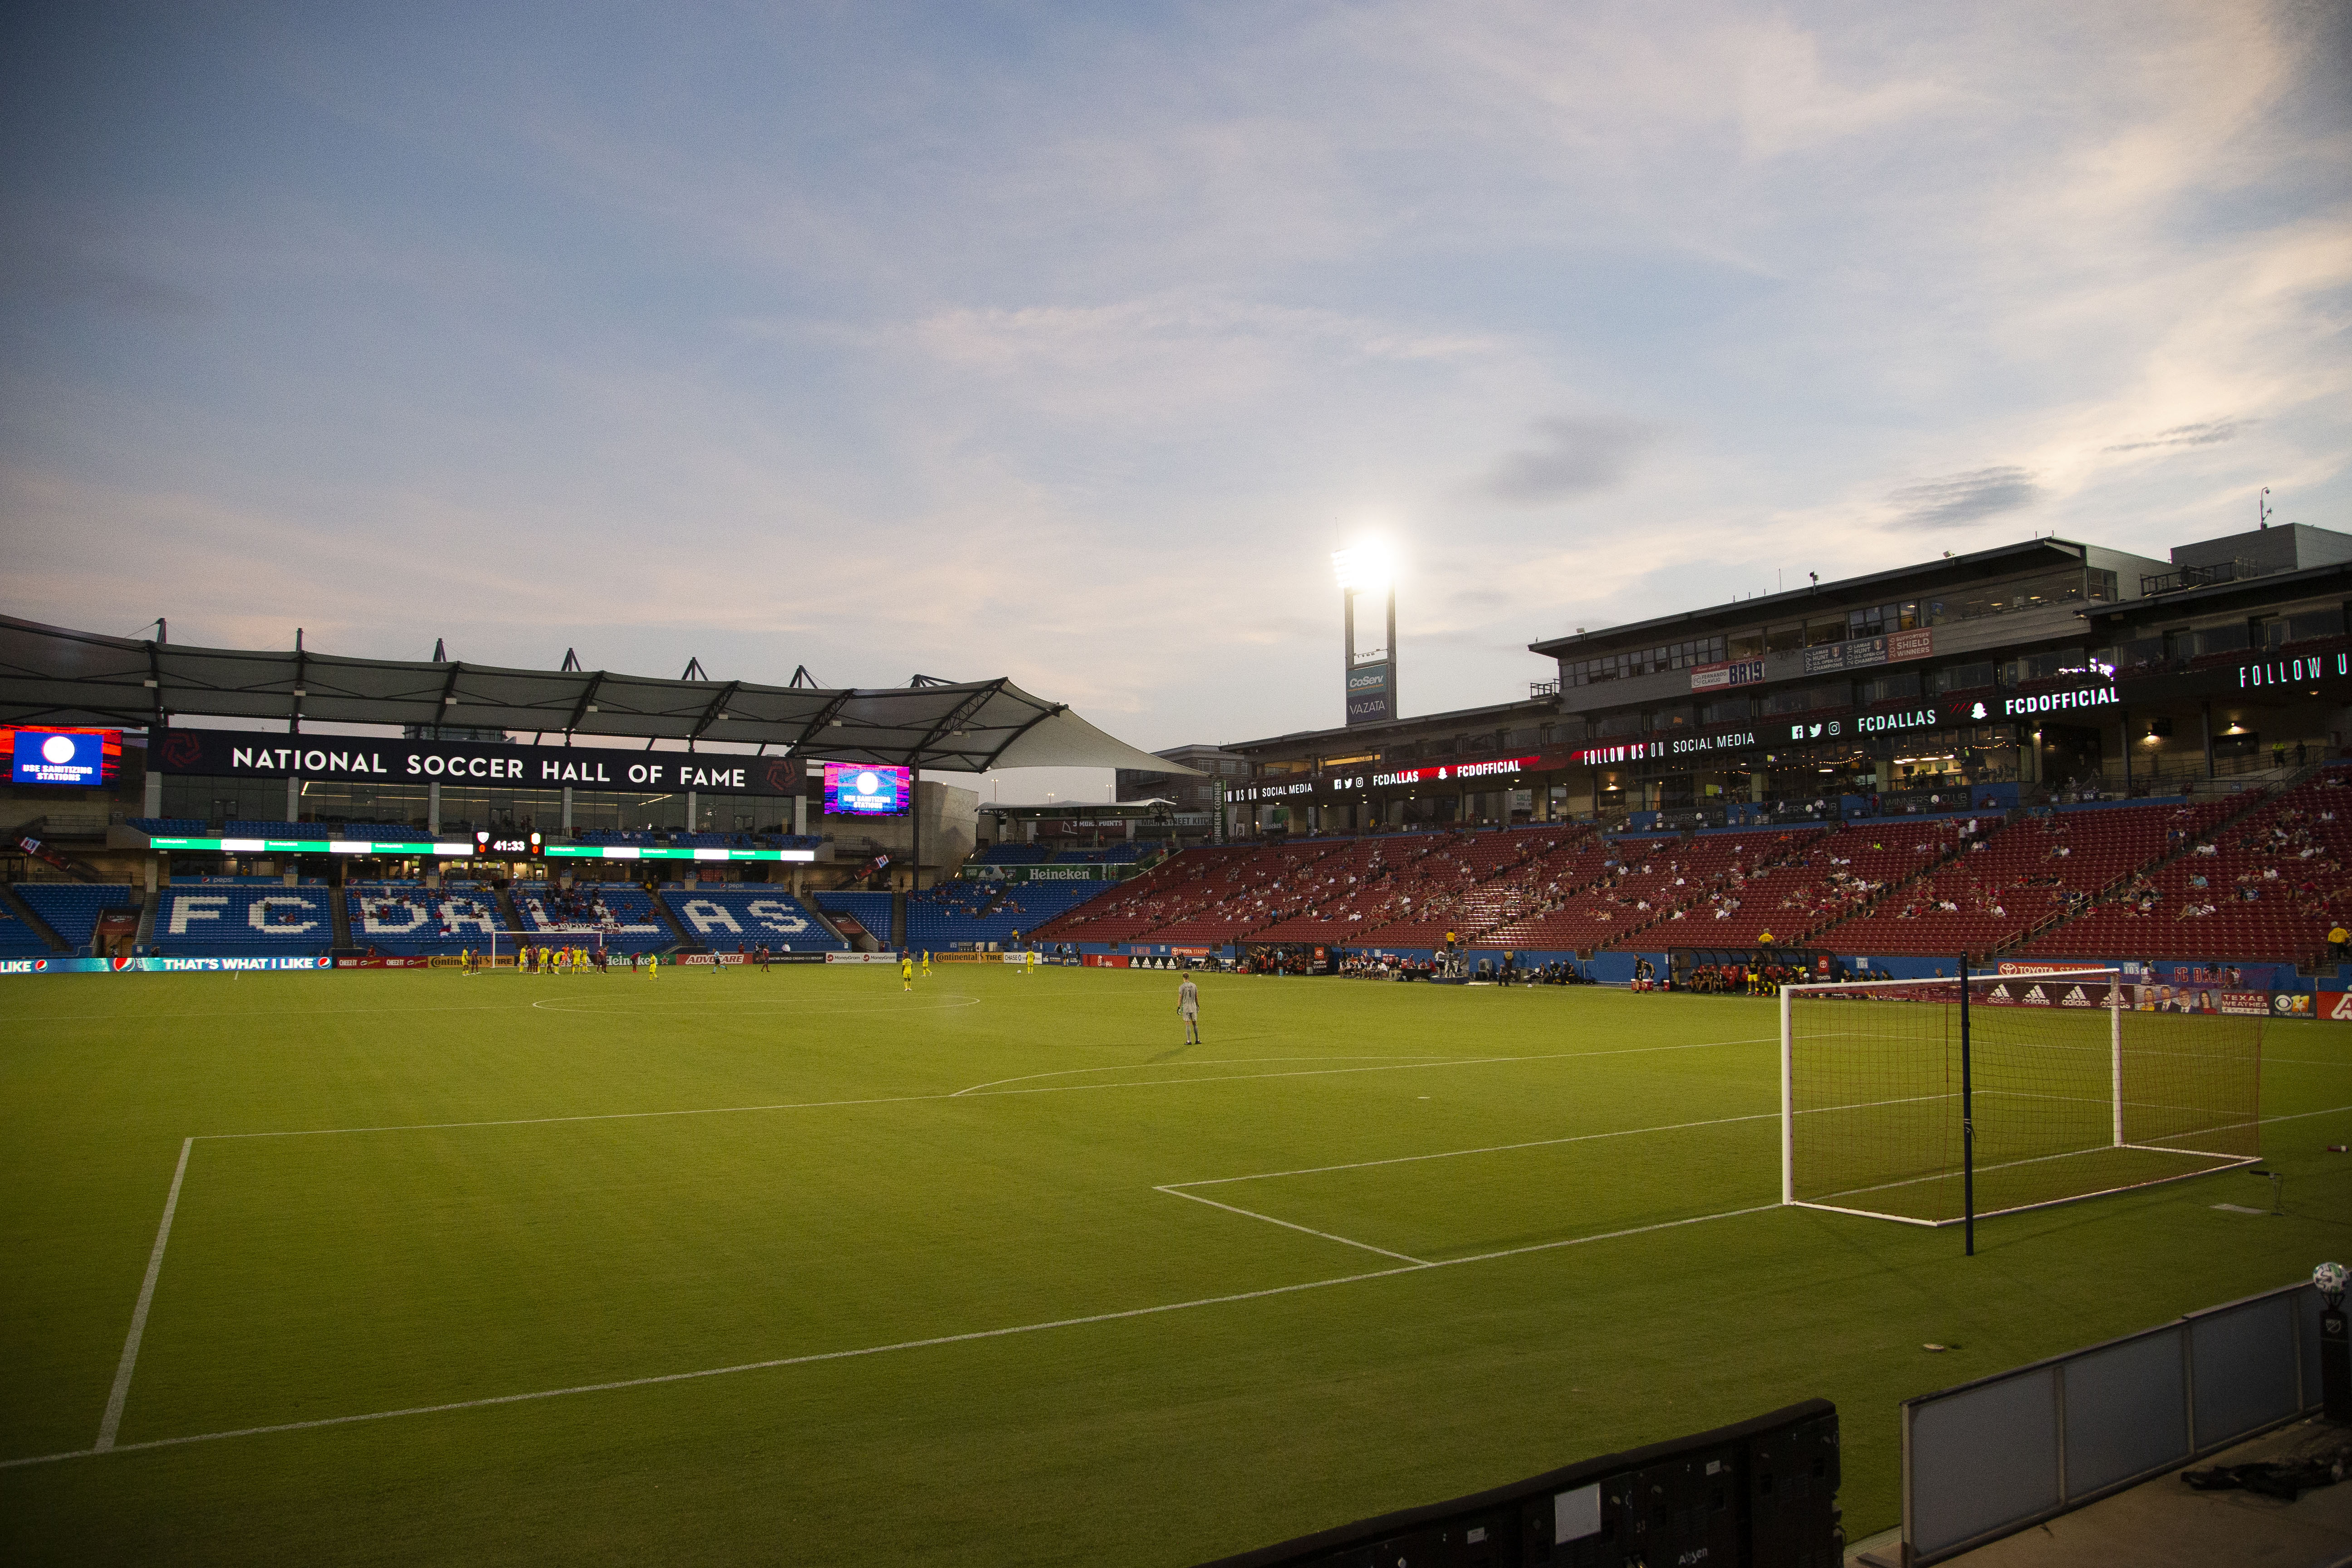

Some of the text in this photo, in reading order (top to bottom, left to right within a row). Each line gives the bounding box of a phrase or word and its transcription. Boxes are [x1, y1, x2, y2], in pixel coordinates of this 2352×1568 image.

[1896, 638, 1929, 650] SHIELD
[1897, 647, 1930, 657] WINNERS
[1813, 662, 1843, 671] CHAMPIONS
[1854, 656, 1886, 665] CHAMPIONS
[1729, 660, 1764, 686] BR19
[2239, 657, 2321, 688] FOLLOW
[1349, 675, 1384, 688] CoServ
[2005, 687, 2119, 715] FCDOFFICIAL
[1349, 700, 1385, 715] VAZATA
[1858, 709, 1936, 732] FCDALLAS
[1584, 732, 1755, 766] FOLLOW US ON SOCIAL MEDIA
[23, 764, 93, 774] USE SANITIZING
[233, 748, 745, 787] NATIONAL SOCCER HALL OF FAME
[1457, 760, 1521, 778] FCDOFFICIAL
[37, 772, 81, 781] STATIONS
[1373, 771, 1419, 786] FCDALLAS
[1236, 789, 1244, 801] US
[1248, 788, 1257, 800] ON
[1262, 786, 1287, 797] SOCIAL
[1289, 783, 1313, 794] MEDIA
[857, 795, 891, 804] SANITIZING
[1884, 795, 1929, 806] WINNERS
[479, 841, 539, 854] 0 41:33 0
[1029, 868, 1090, 880] Heineken
[168, 897, 318, 934] FC
[936, 953, 978, 962] Continental
[0, 961, 32, 973] LIKE
[164, 958, 314, 970] THAT'S WHAT I LIKE
[2019, 966, 2054, 974] TOYOTA
[2125, 966, 2139, 975] 103
[2175, 967, 2189, 982] FC
